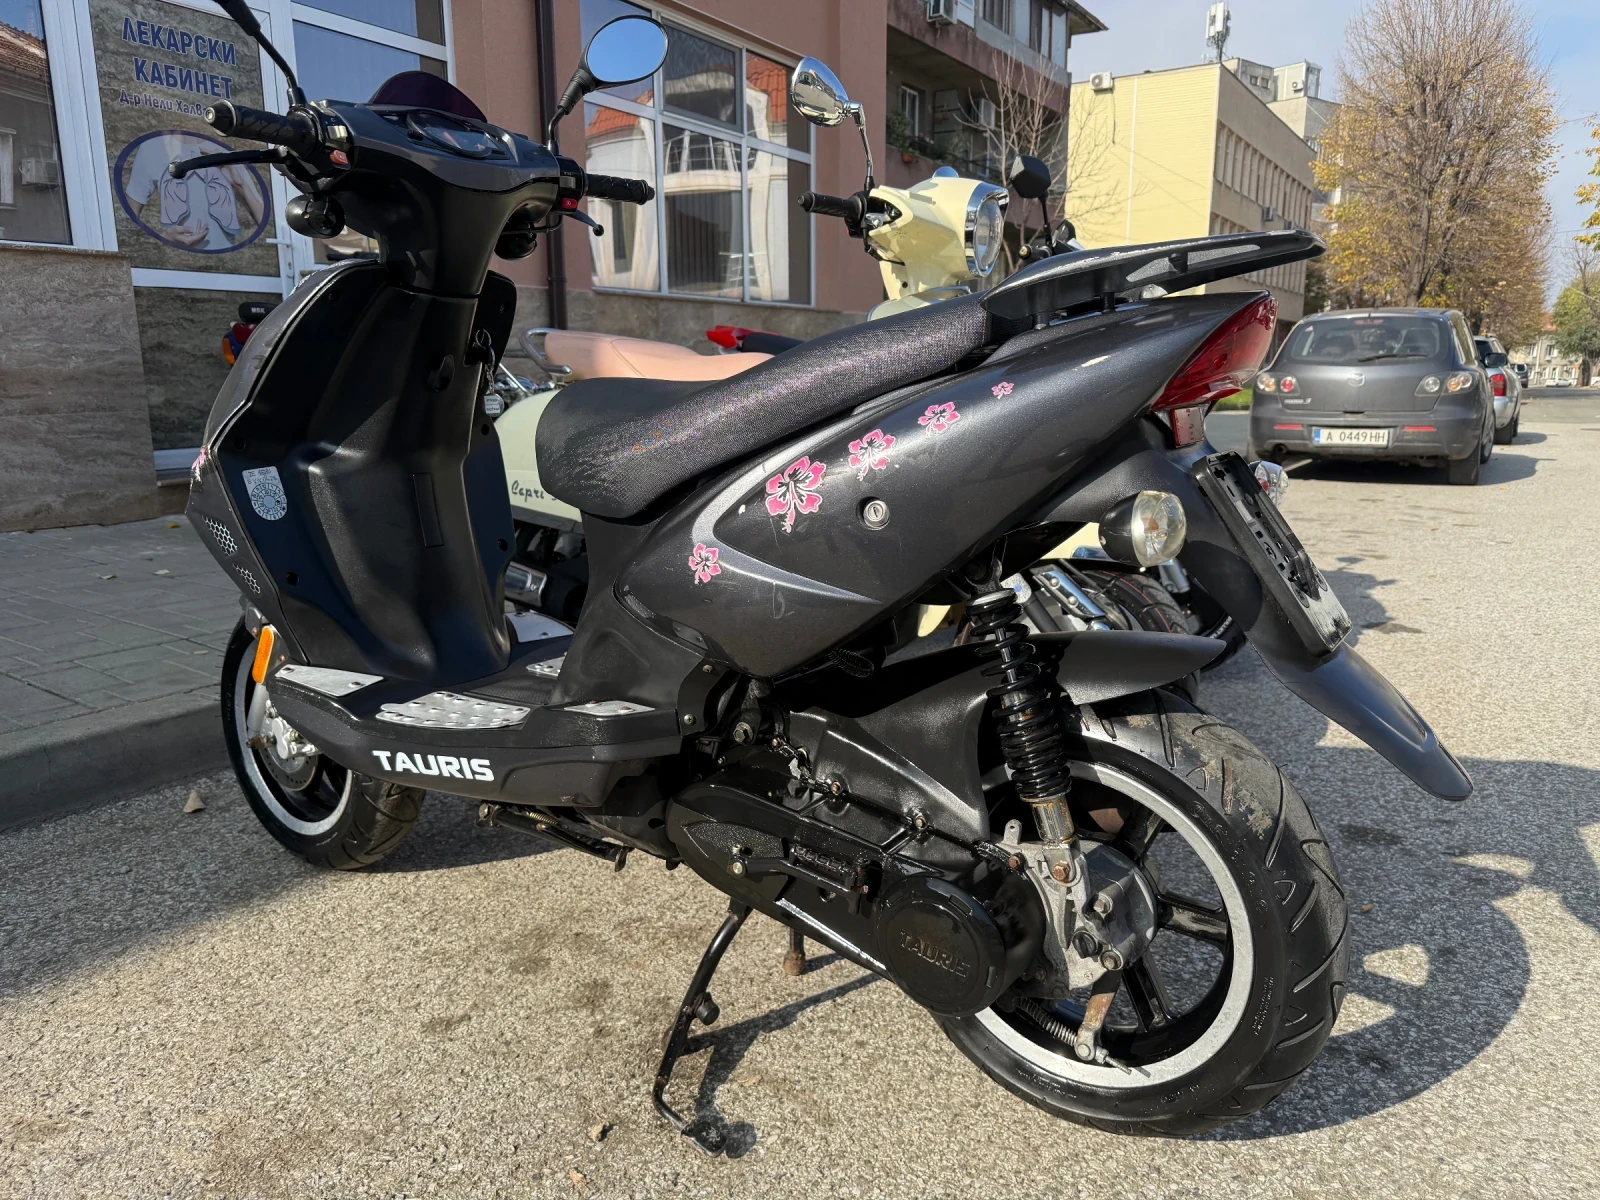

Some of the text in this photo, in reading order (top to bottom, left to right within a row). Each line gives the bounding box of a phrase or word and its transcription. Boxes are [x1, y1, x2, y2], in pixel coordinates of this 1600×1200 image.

[123, 17, 236, 65] ЛЕКАРСКИ
[134, 57, 232, 98] КАБИНЕТ
[119, 89, 141, 107] Д-р
[144, 93, 173, 112] Нели
[1326, 431, 1333, 442] A
[511, 479, 545, 502] Capri
[371, 749, 495, 782] TAURIS
